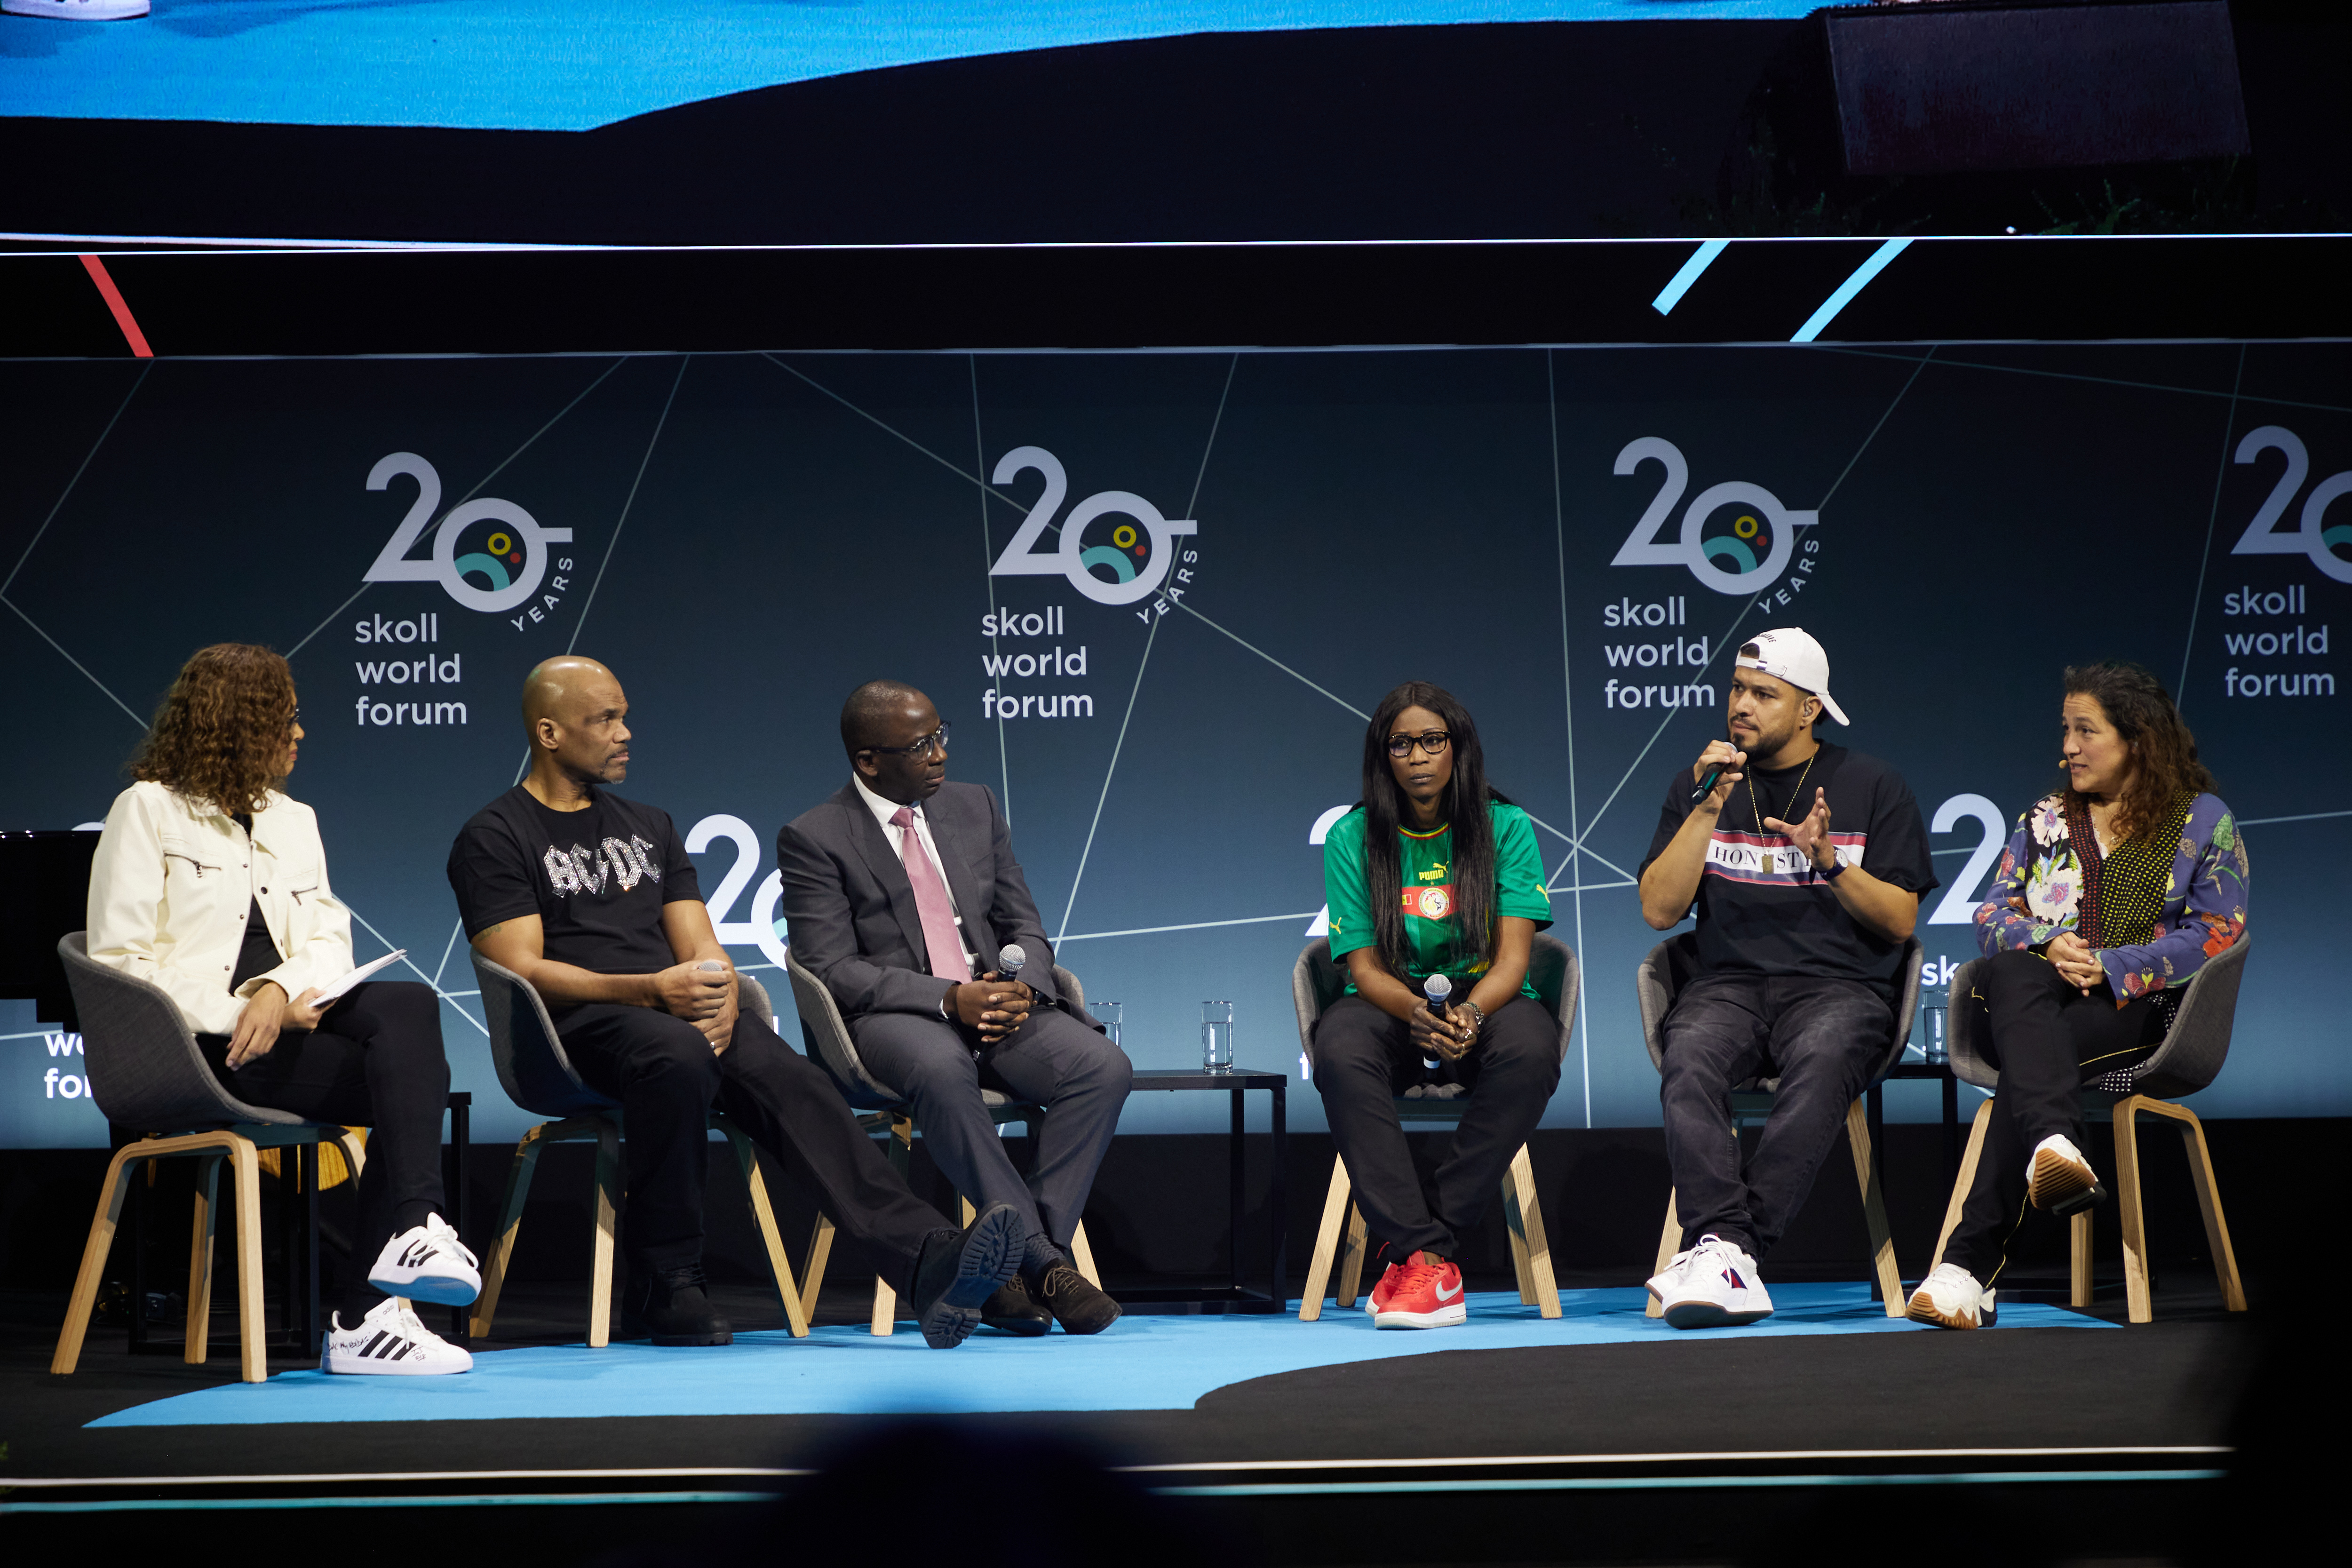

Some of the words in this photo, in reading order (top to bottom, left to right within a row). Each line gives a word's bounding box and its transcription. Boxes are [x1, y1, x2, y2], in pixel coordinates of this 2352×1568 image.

[988, 446, 1197, 605] 20
[1610, 437, 1819, 595] 20
[362, 452, 572, 612] 20
[1136, 549, 1198, 625] YEARS
[1758, 540, 1819, 614] YEARS
[511, 557, 573, 632] YEARS
[2225, 585, 2305, 615] skoll
[982, 606, 1063, 636] skoll
[1604, 596, 1685, 626] skoll
[355, 613, 437, 643] skoll
[2225, 625, 2328, 655] world
[982, 646, 1087, 677] world
[1605, 636, 1708, 667] world
[356, 653, 461, 684] world
[2225, 667, 2335, 697] forum
[982, 689, 1093, 718] forum
[1605, 679, 1715, 708] forum
[356, 696, 467, 725] forum
[1714, 845, 1812, 868] HONST
[1419, 869, 1444, 881] PUMA
